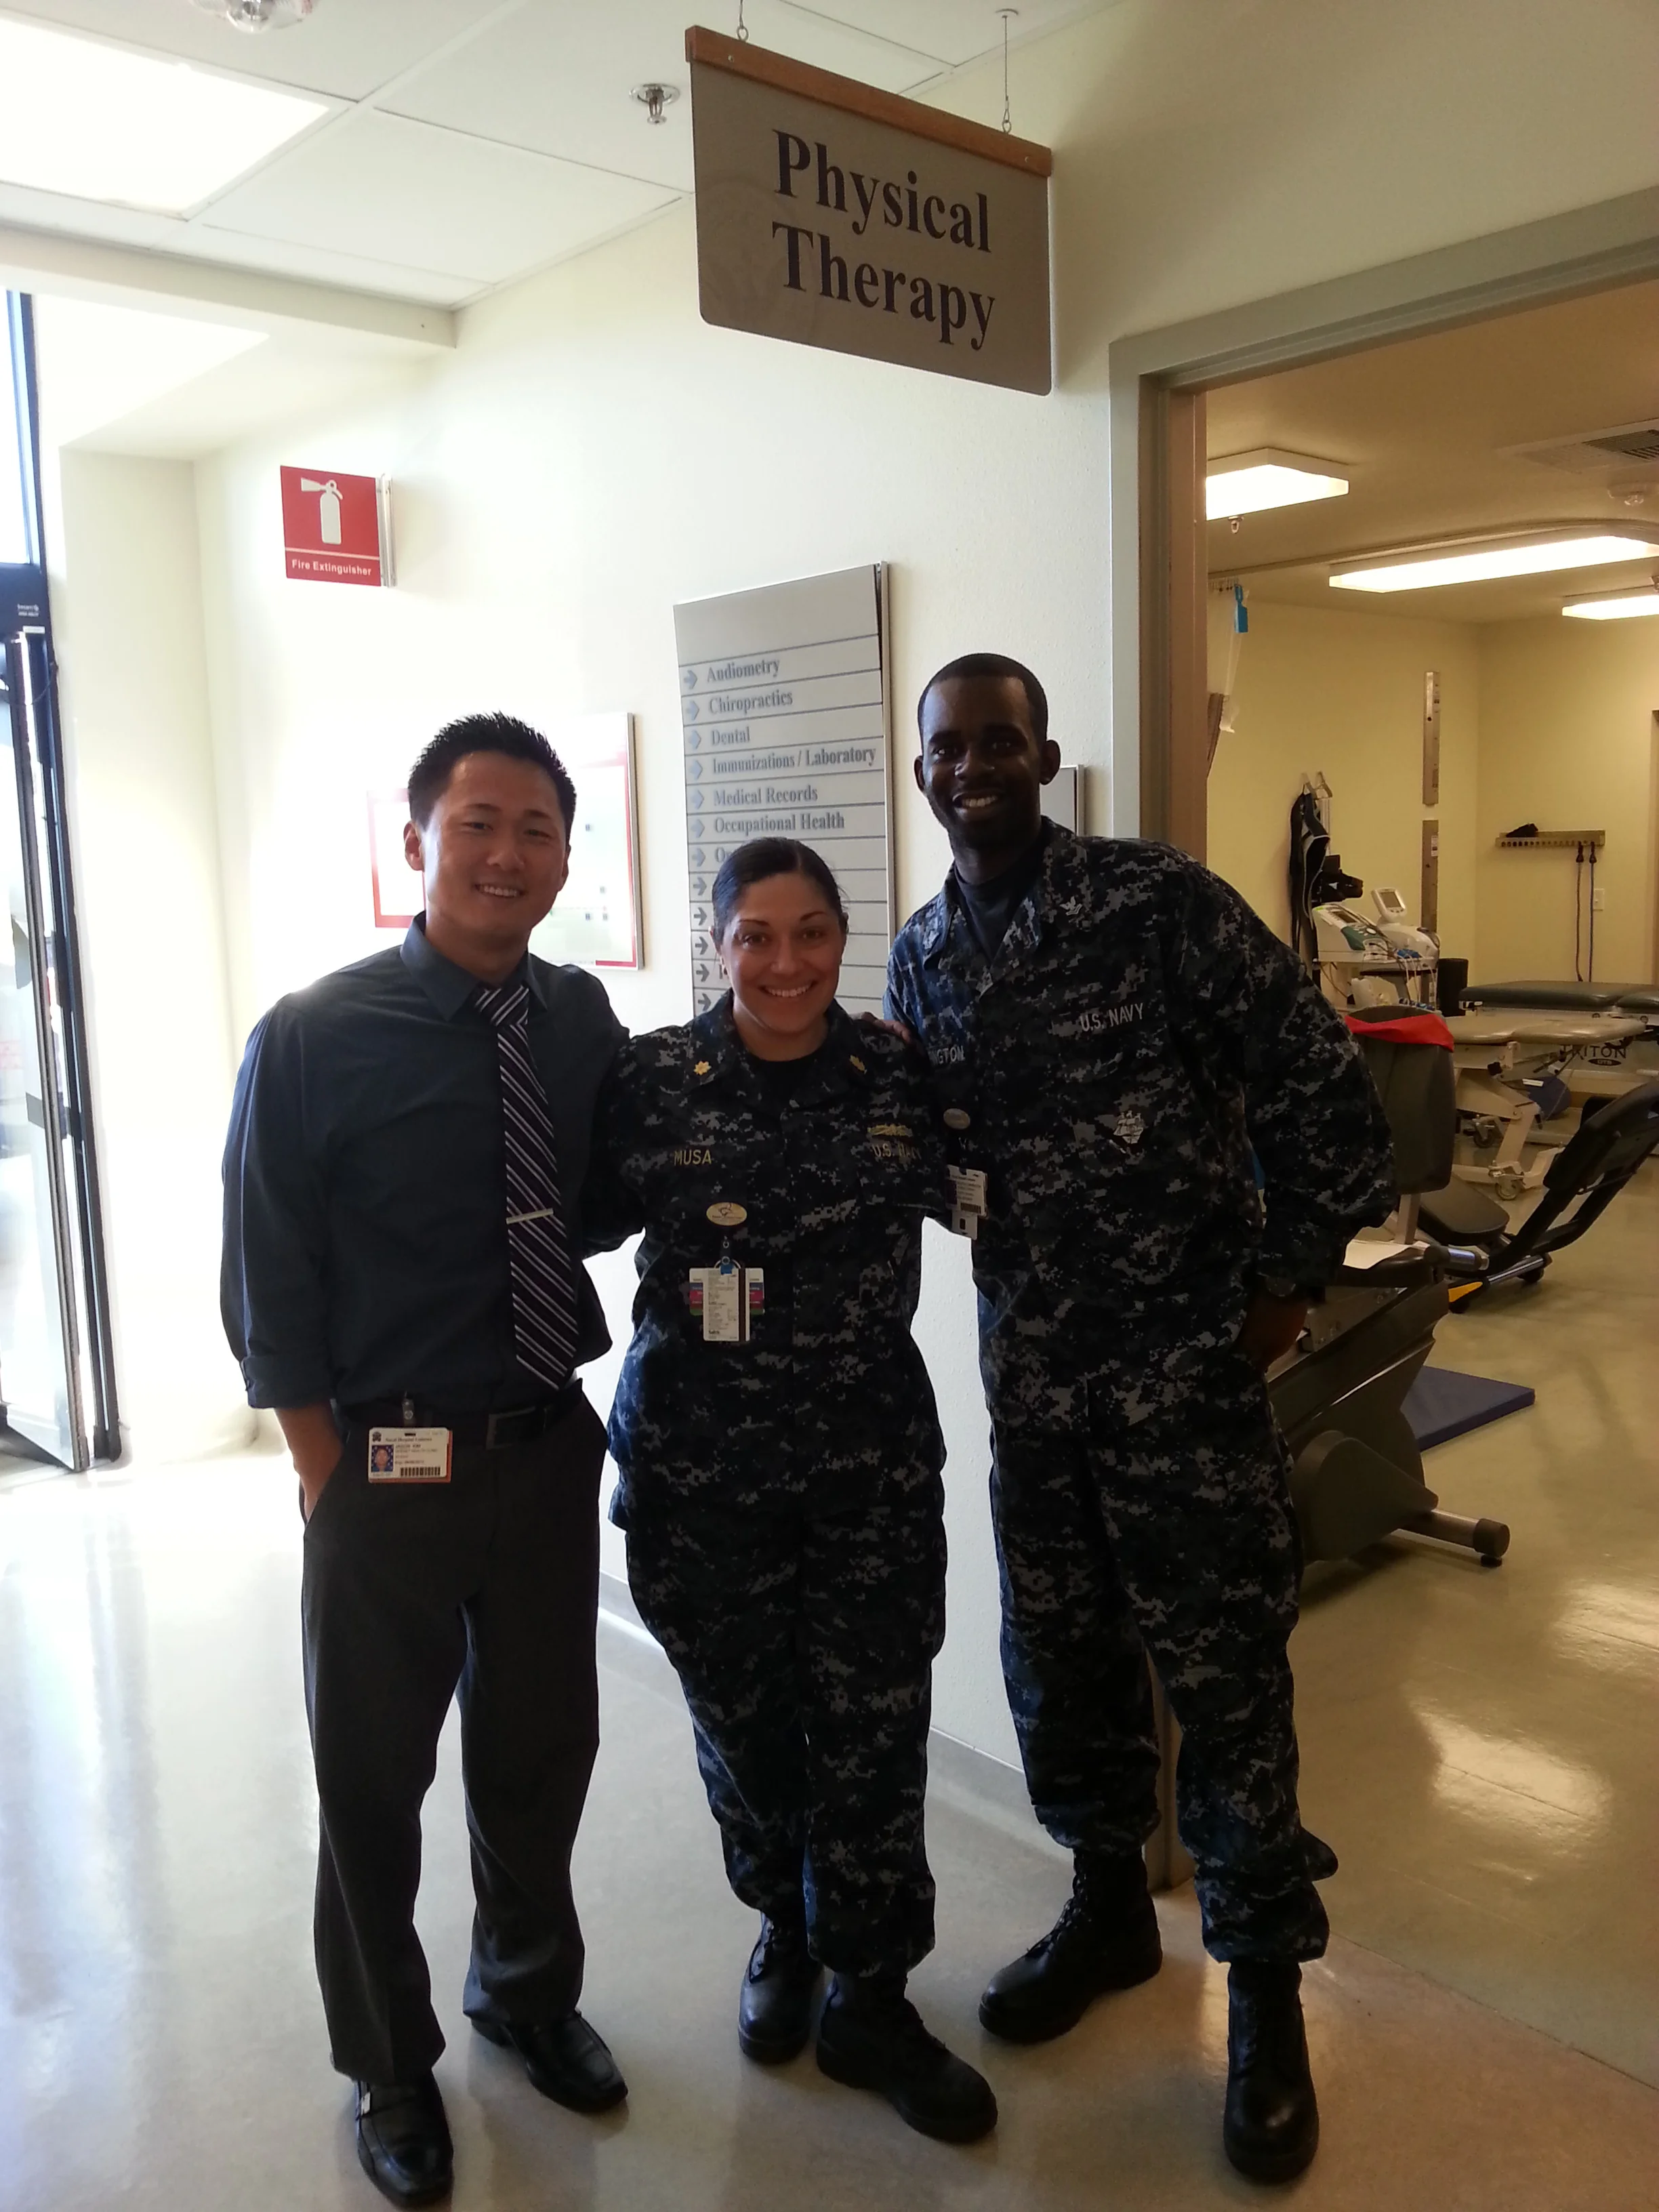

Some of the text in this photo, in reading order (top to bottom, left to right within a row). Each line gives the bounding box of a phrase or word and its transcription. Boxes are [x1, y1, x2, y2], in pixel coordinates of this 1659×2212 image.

[773, 128, 991, 253] Physical
[773, 221, 996, 350] Therapy
[291, 558, 372, 576] Fire Extinguisher
[708, 659, 780, 682] Audiometry
[709, 690, 793, 714] Chiropractics
[711, 726, 750, 745] Dental
[713, 747, 876, 774] Immunizations / Laboratory
[714, 785, 818, 806] Medical Records
[715, 812, 845, 836] Occupational Health
[1080, 1003, 1143, 1031] U.S. NAVY
[674, 1149, 712, 1166] MUSA
